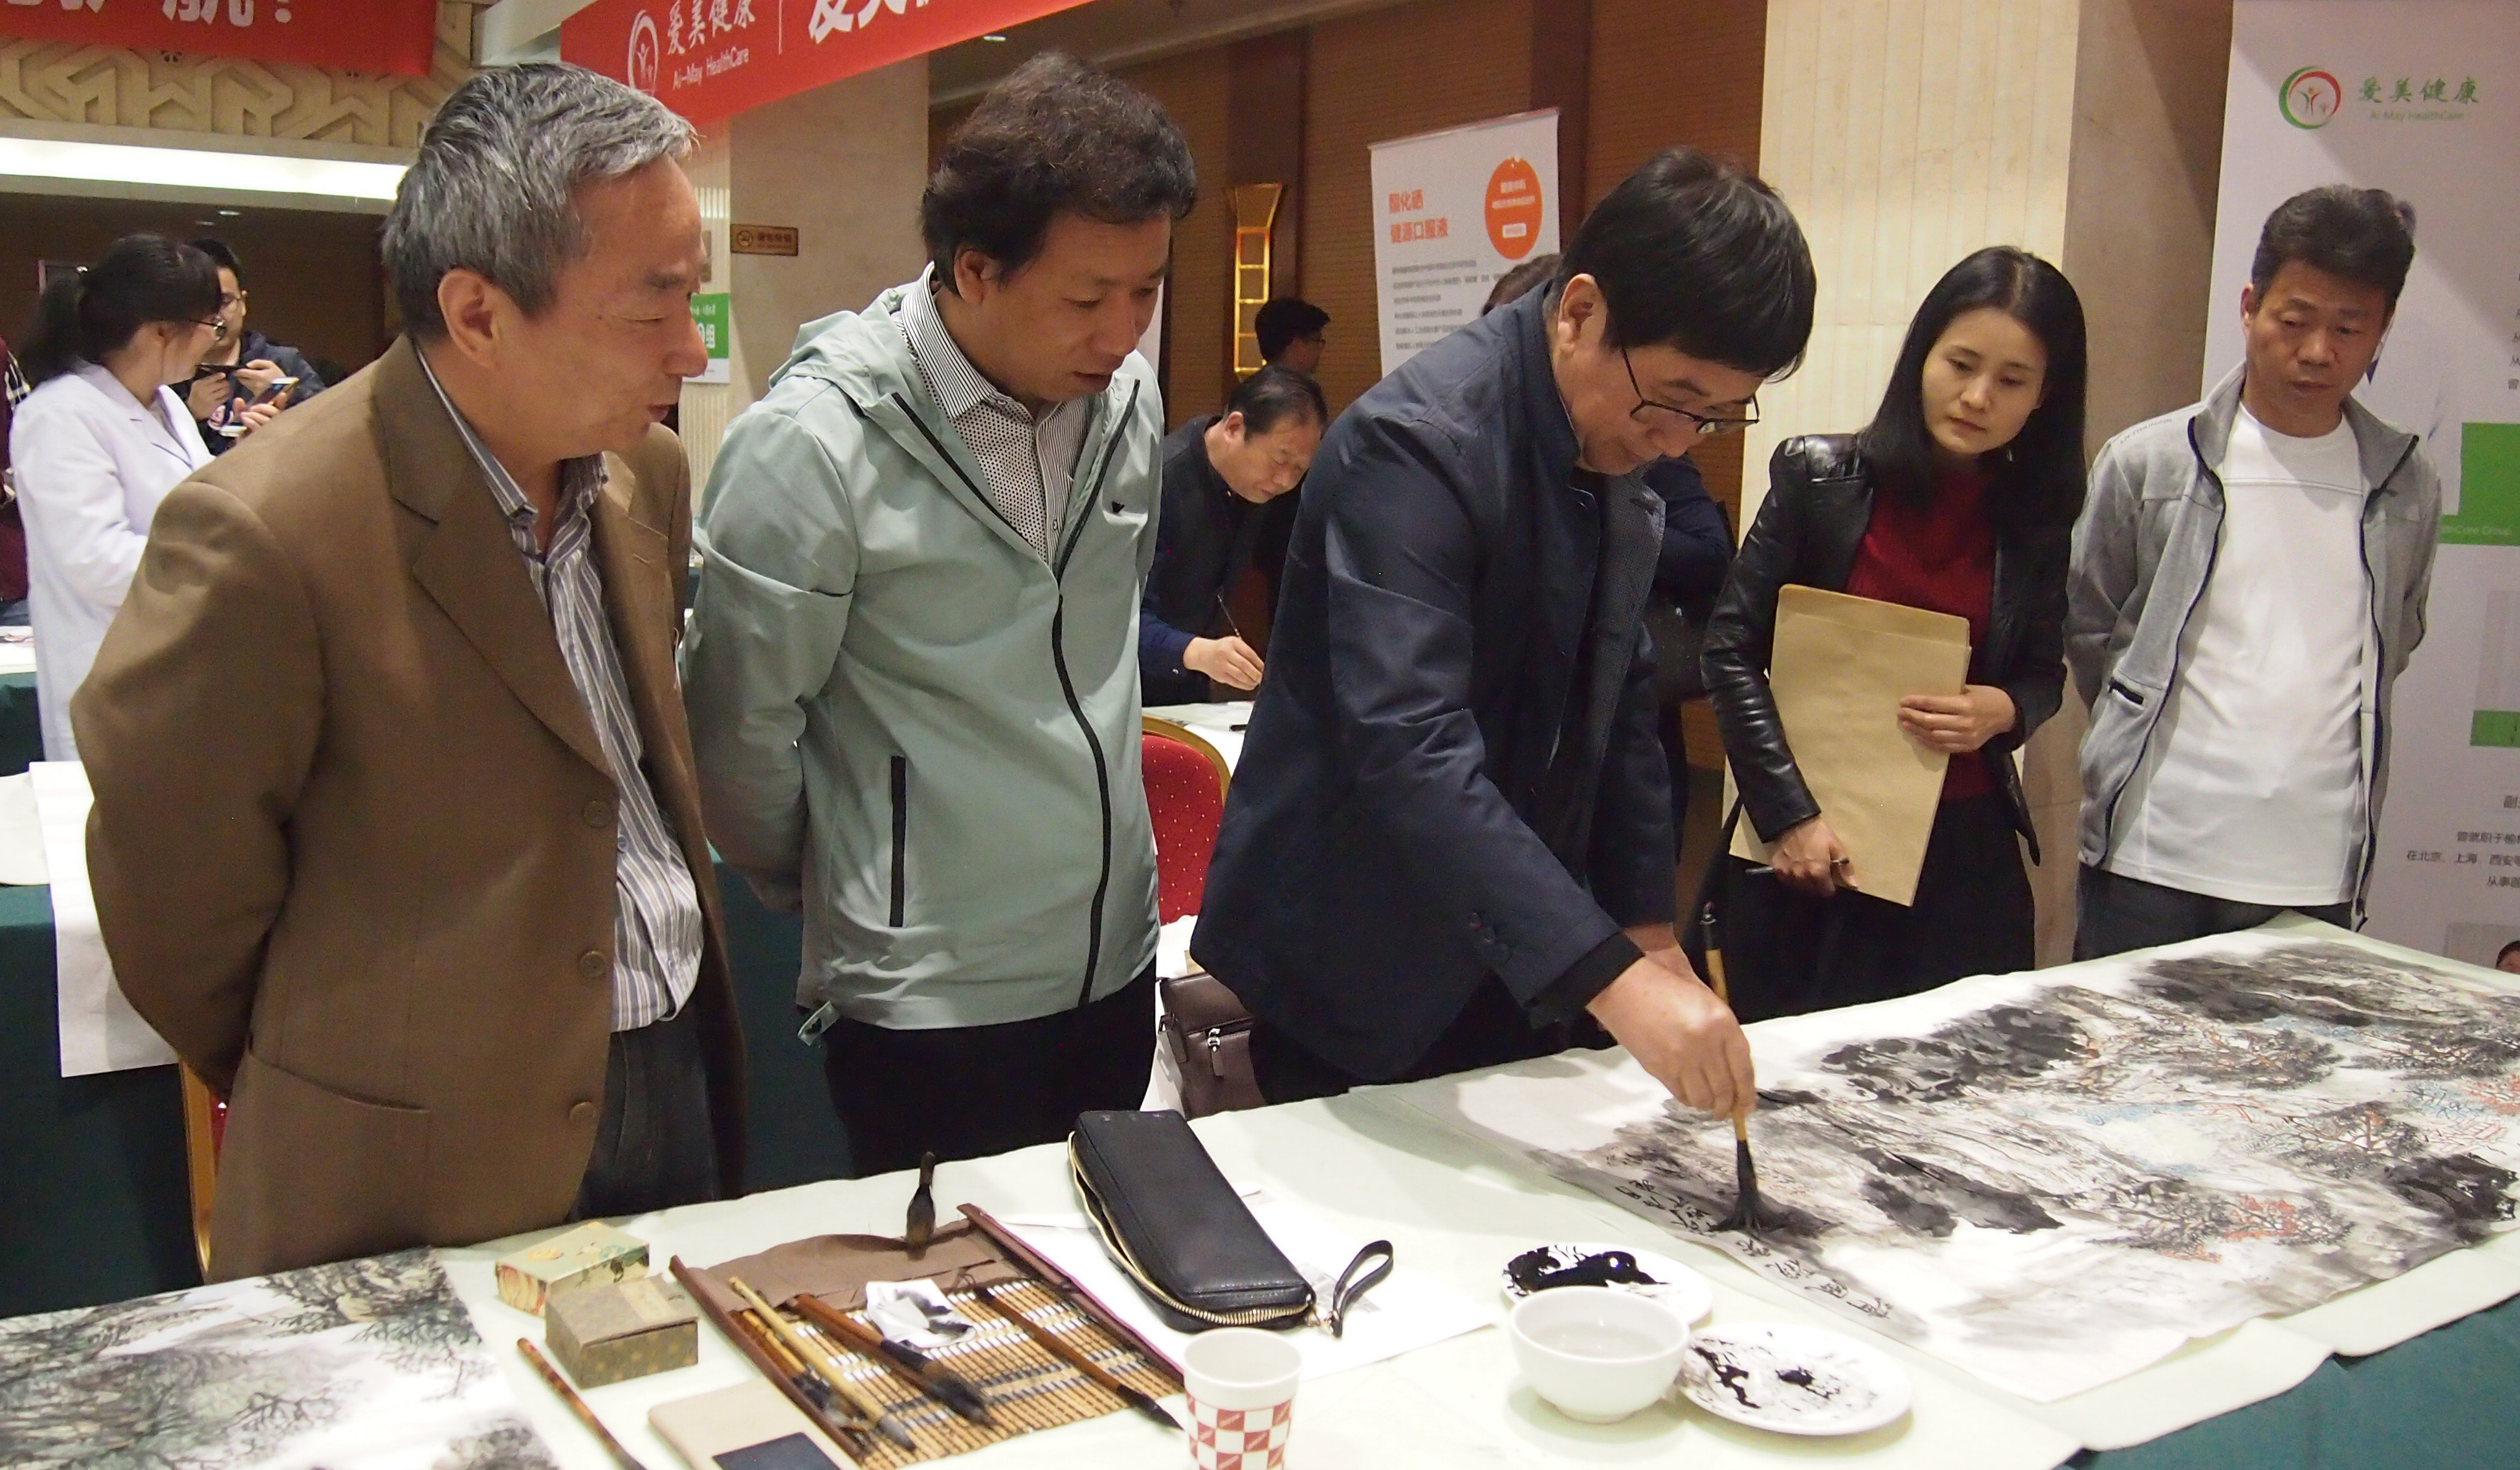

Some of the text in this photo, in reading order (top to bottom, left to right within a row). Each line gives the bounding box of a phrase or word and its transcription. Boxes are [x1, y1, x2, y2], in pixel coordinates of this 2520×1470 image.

[667, 0, 756, 55] 爱美健康
[706, 46, 749, 78] HealthCare
[2358, 76, 2479, 104] 爱美健康
